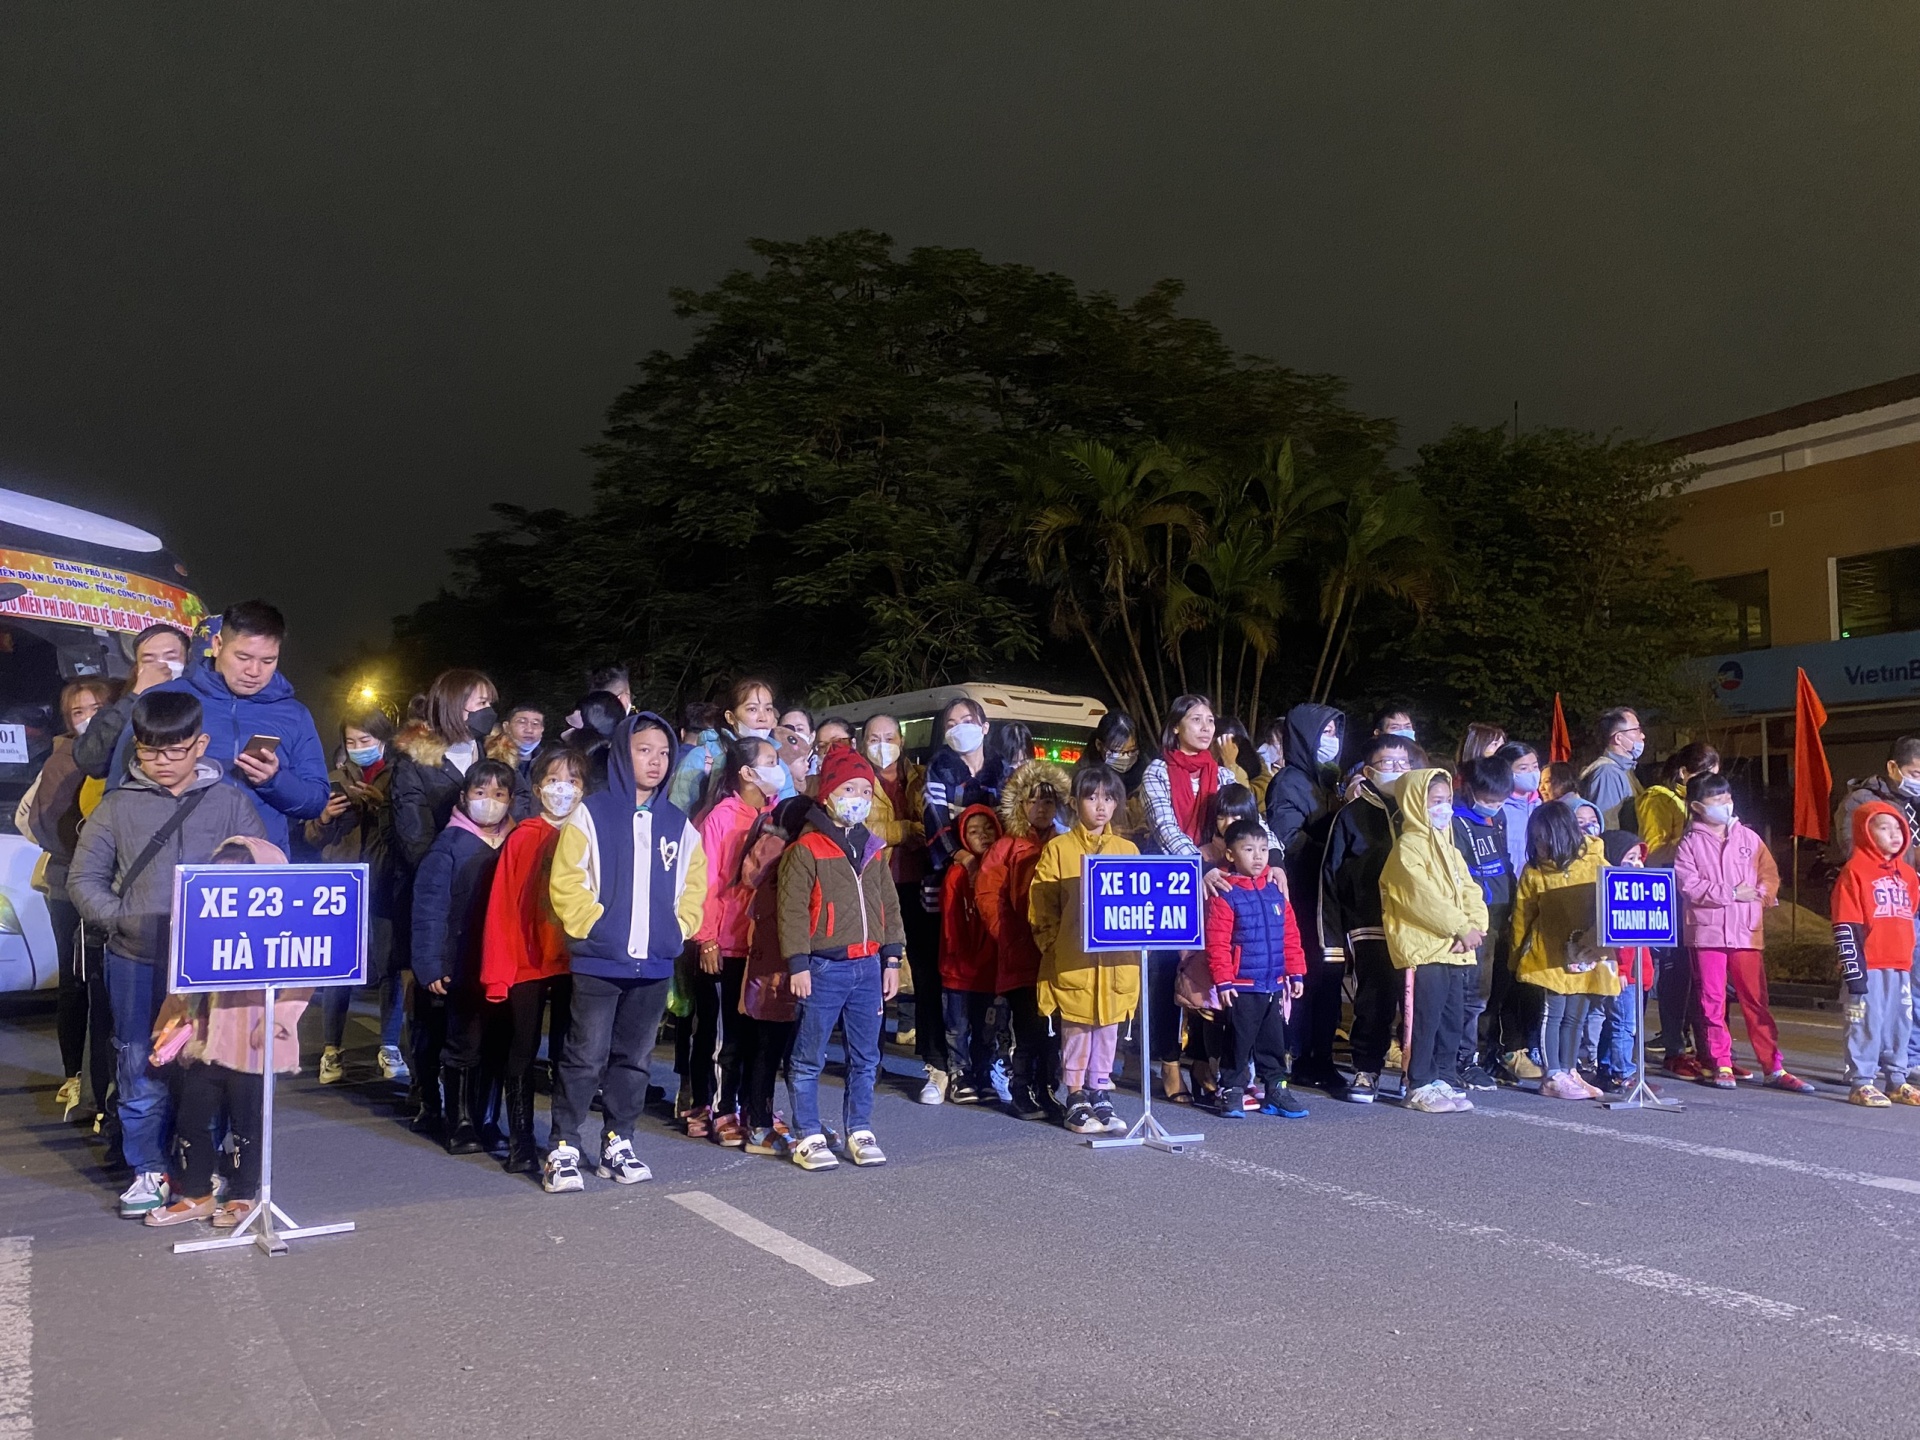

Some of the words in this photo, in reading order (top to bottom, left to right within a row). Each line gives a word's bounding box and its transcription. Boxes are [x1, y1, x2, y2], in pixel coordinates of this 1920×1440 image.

[18, 570, 44, 582] ĐOÀN
[46, 575, 64, 585] LAO
[53, 561, 83, 574] THÀNH
[43, 596, 60, 617] PHÍ
[60, 601, 78, 620] ĐƯA
[112, 609, 127, 628] QUÊ
[1100, 872, 1124, 895] XE
[1129, 871, 1151, 895] 10
[1168, 872, 1191, 895] 22
[1614, 881, 1630, 901] XE
[1652, 882, 1666, 901] 09
[200, 888, 238, 918] XE
[248, 887, 284, 917] 23
[312, 886, 347, 916] 25
[1104, 901, 1155, 935] NGHỆ
[1160, 905, 1187, 930] AN
[1612, 910, 1647, 930] THANH
[1648, 906, 1670, 930] HÓA
[212, 931, 254, 971] HÀ
[263, 931, 332, 969] TĨNH
